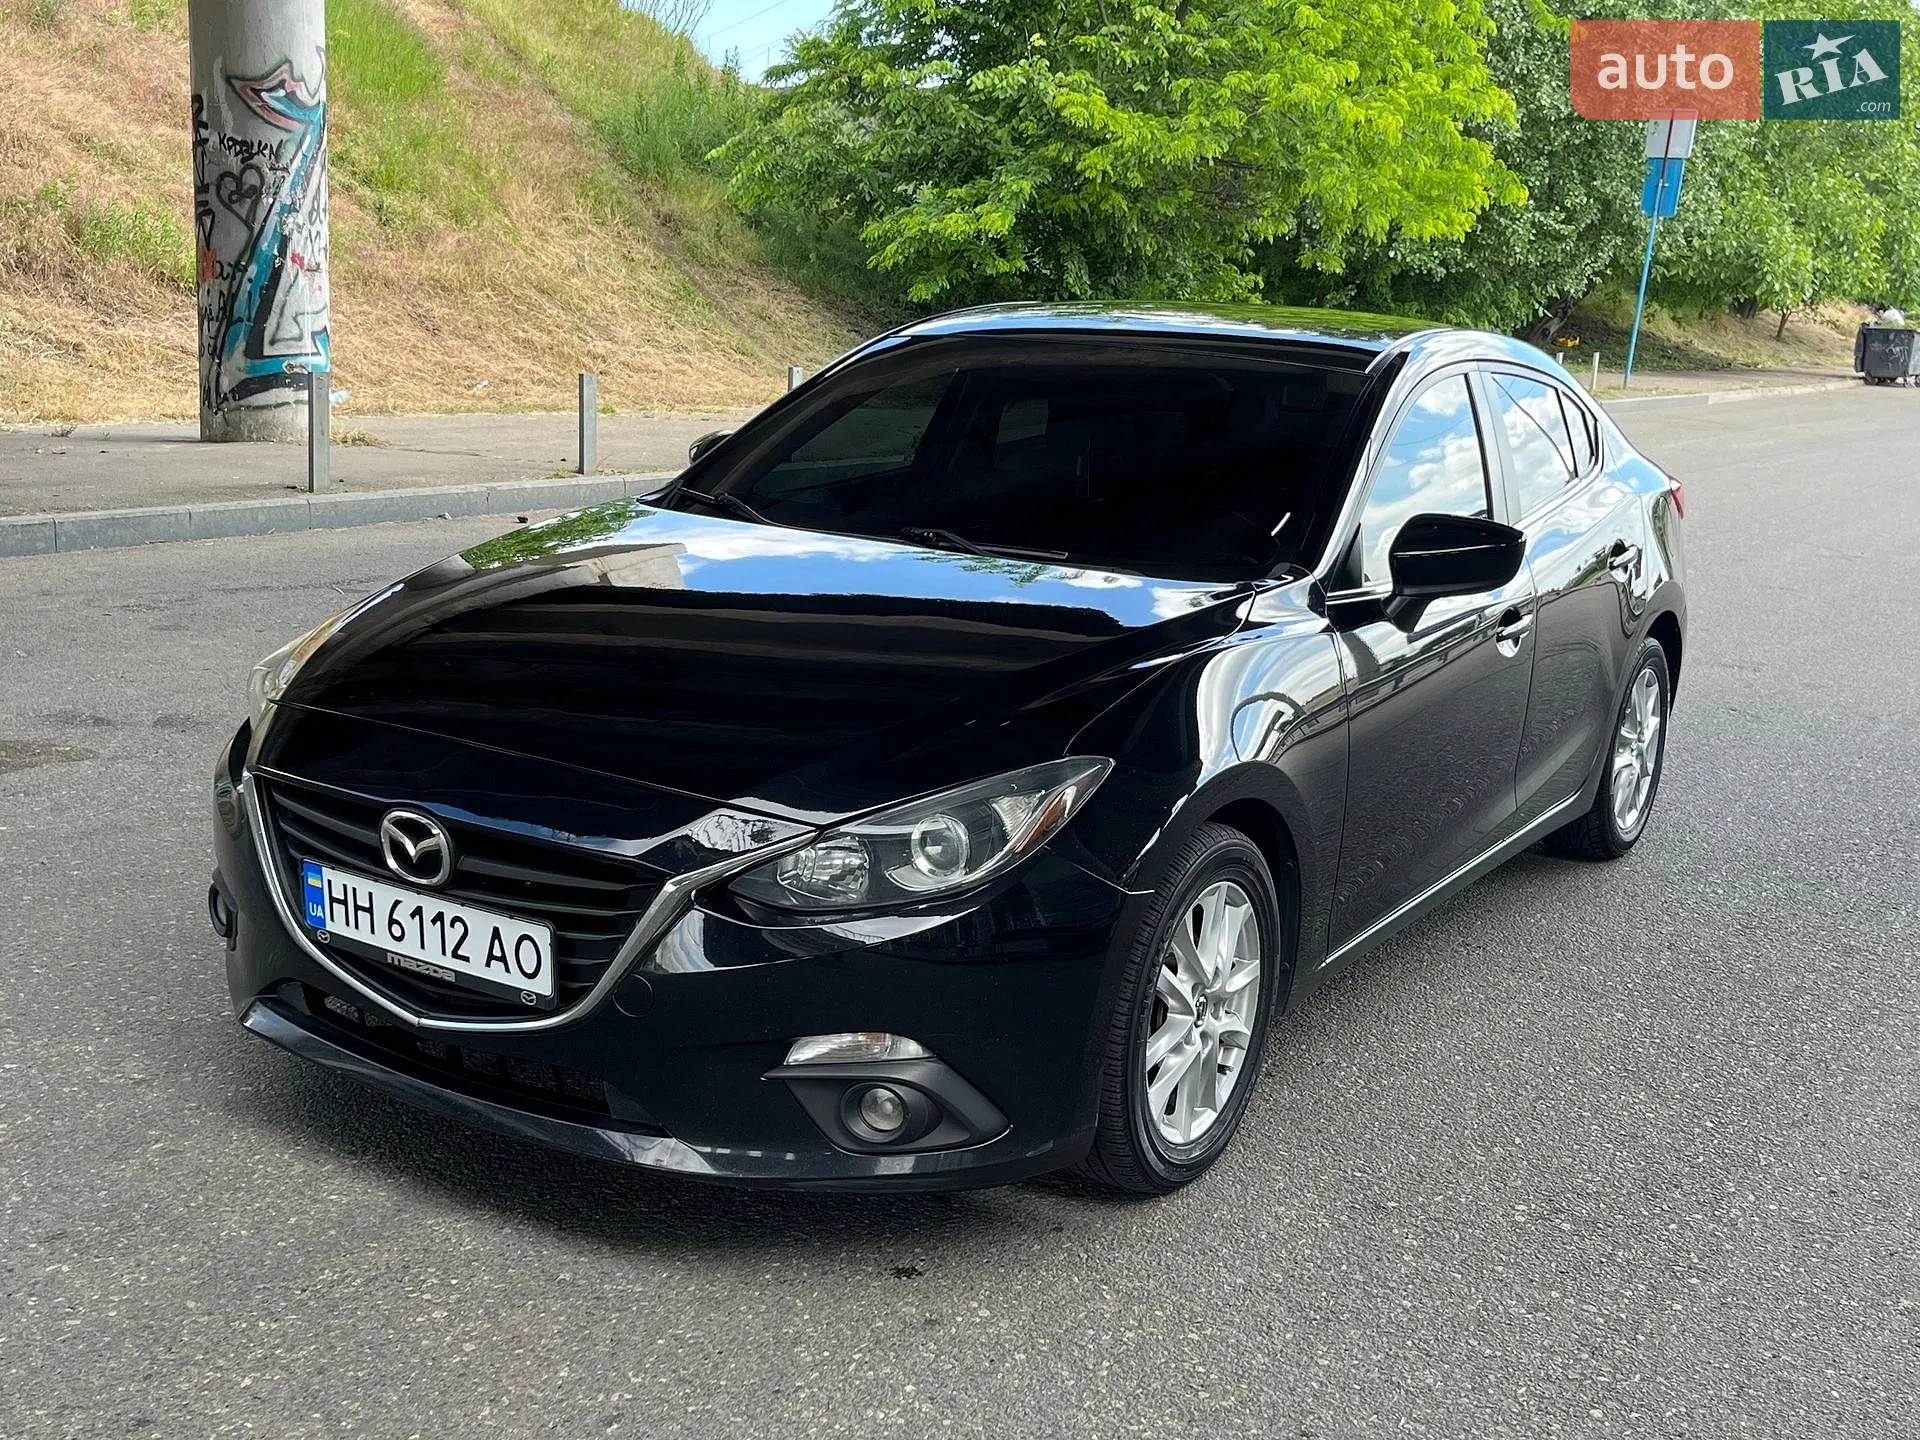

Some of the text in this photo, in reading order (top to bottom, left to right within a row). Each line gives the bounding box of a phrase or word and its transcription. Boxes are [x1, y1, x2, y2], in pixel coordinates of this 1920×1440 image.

[309, 904, 324, 919] UA
[327, 878, 542, 980] HH 6112 AO
